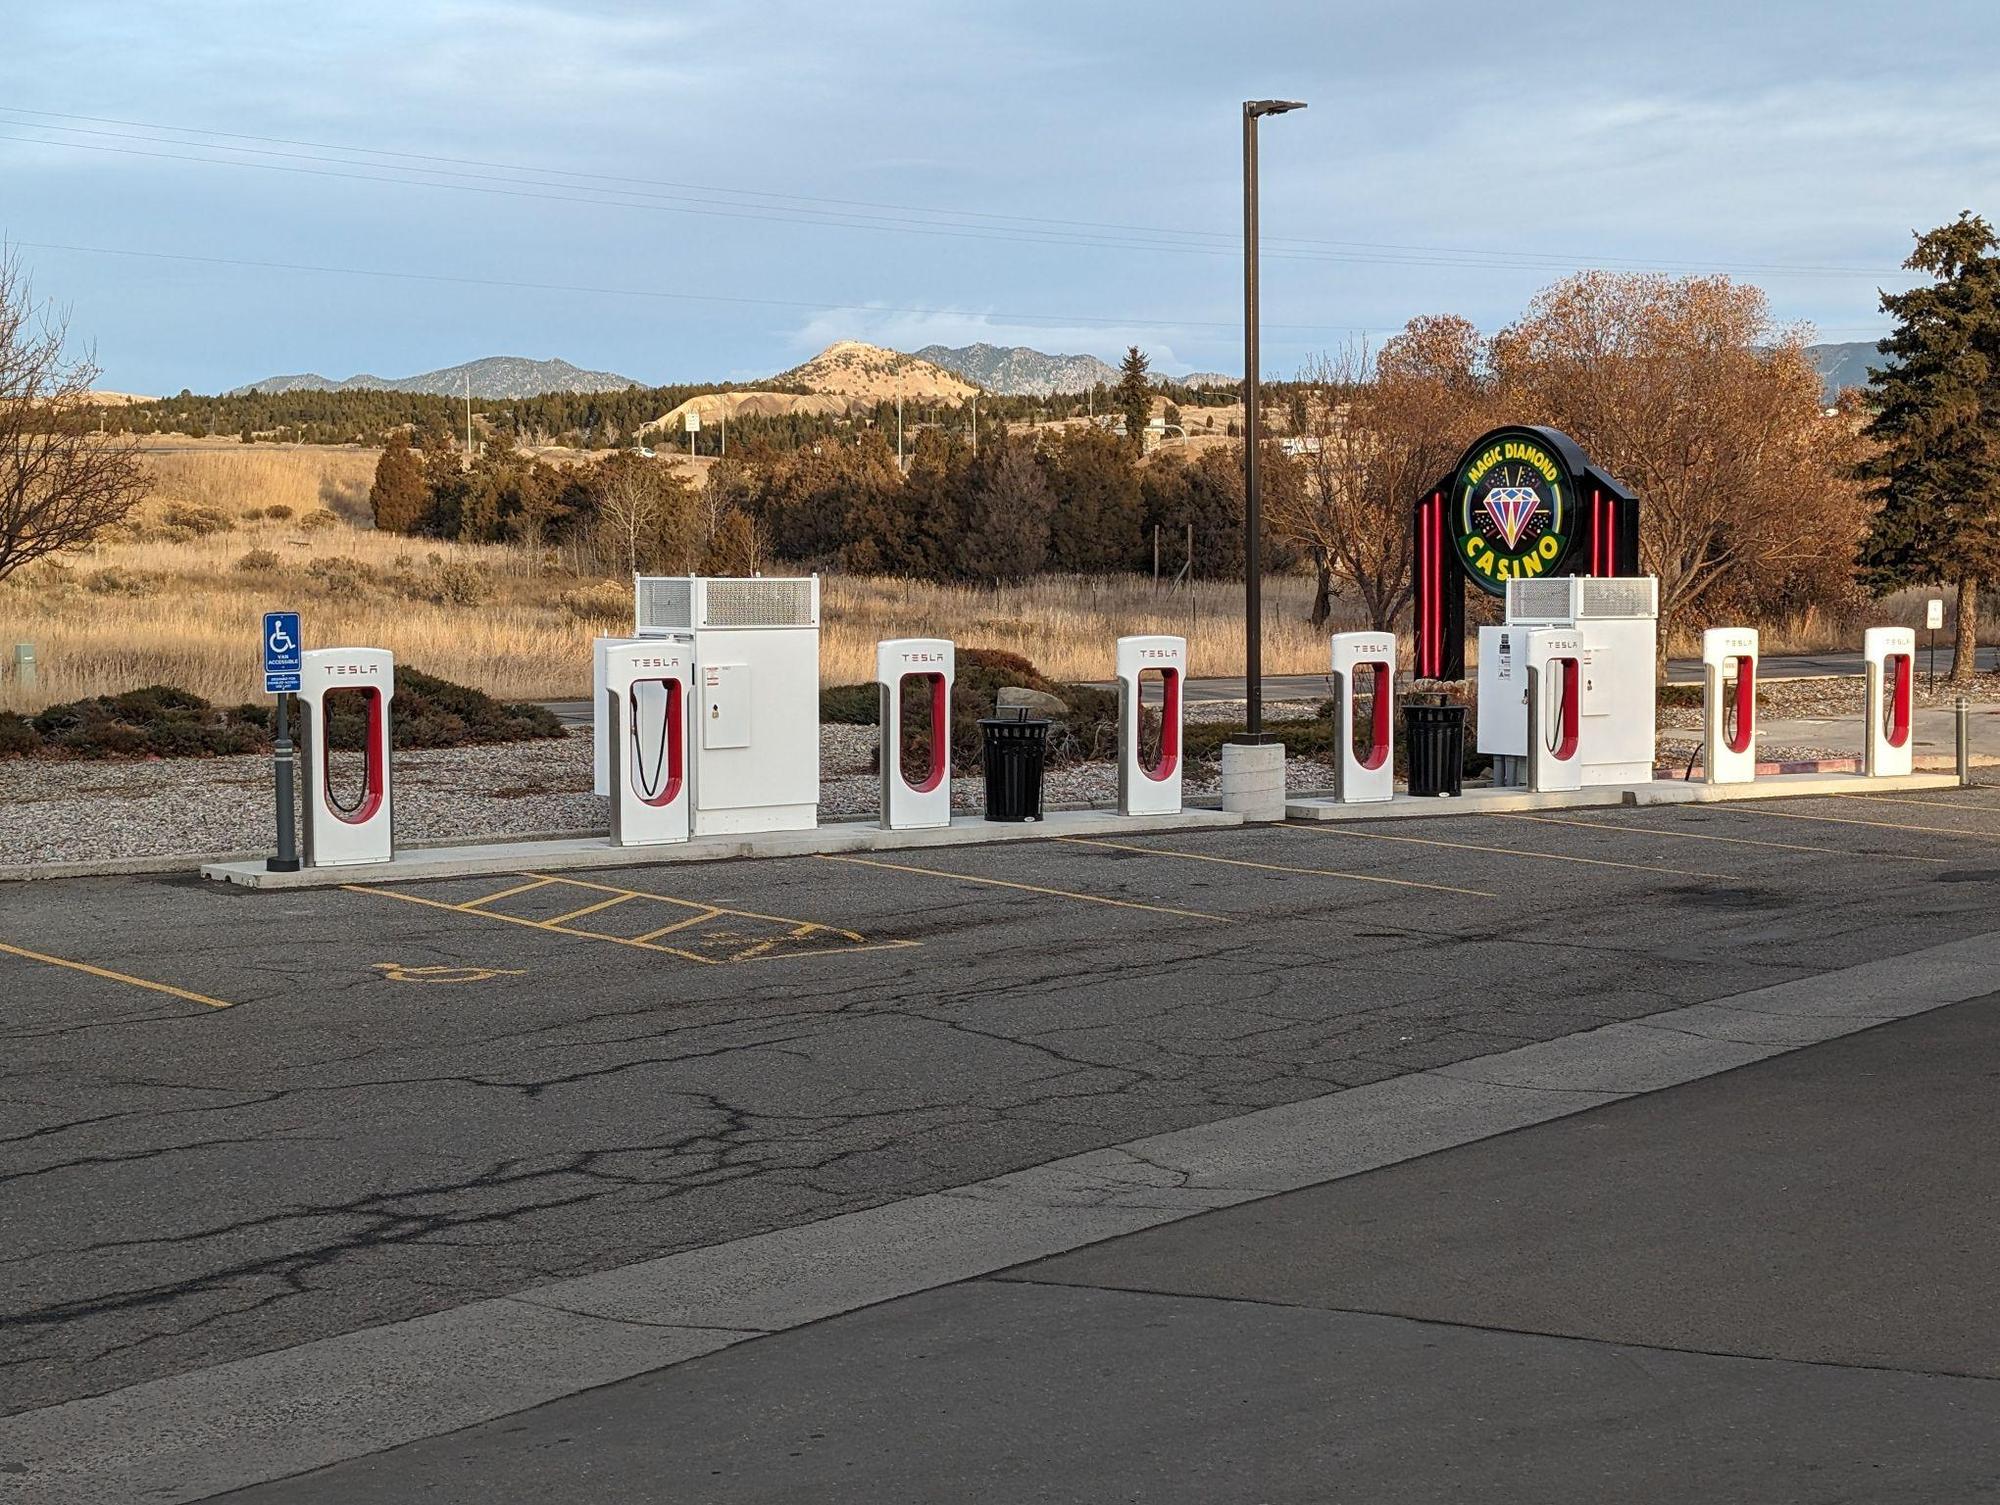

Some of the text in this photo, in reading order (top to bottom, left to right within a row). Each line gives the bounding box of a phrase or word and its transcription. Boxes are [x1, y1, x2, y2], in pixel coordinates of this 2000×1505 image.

[1468, 443, 1558, 484] MAGIC DIAMOND
[1467, 535, 1559, 581] CASINO
[1353, 644, 1388, 653] TESLA
[1548, 641, 1578, 649] TESLA
[901, 653, 944, 662] TESLA
[1140, 649, 1178, 658] TESLA
[631, 658, 679, 667] TESLA
[324, 664, 378, 675] TESLA
